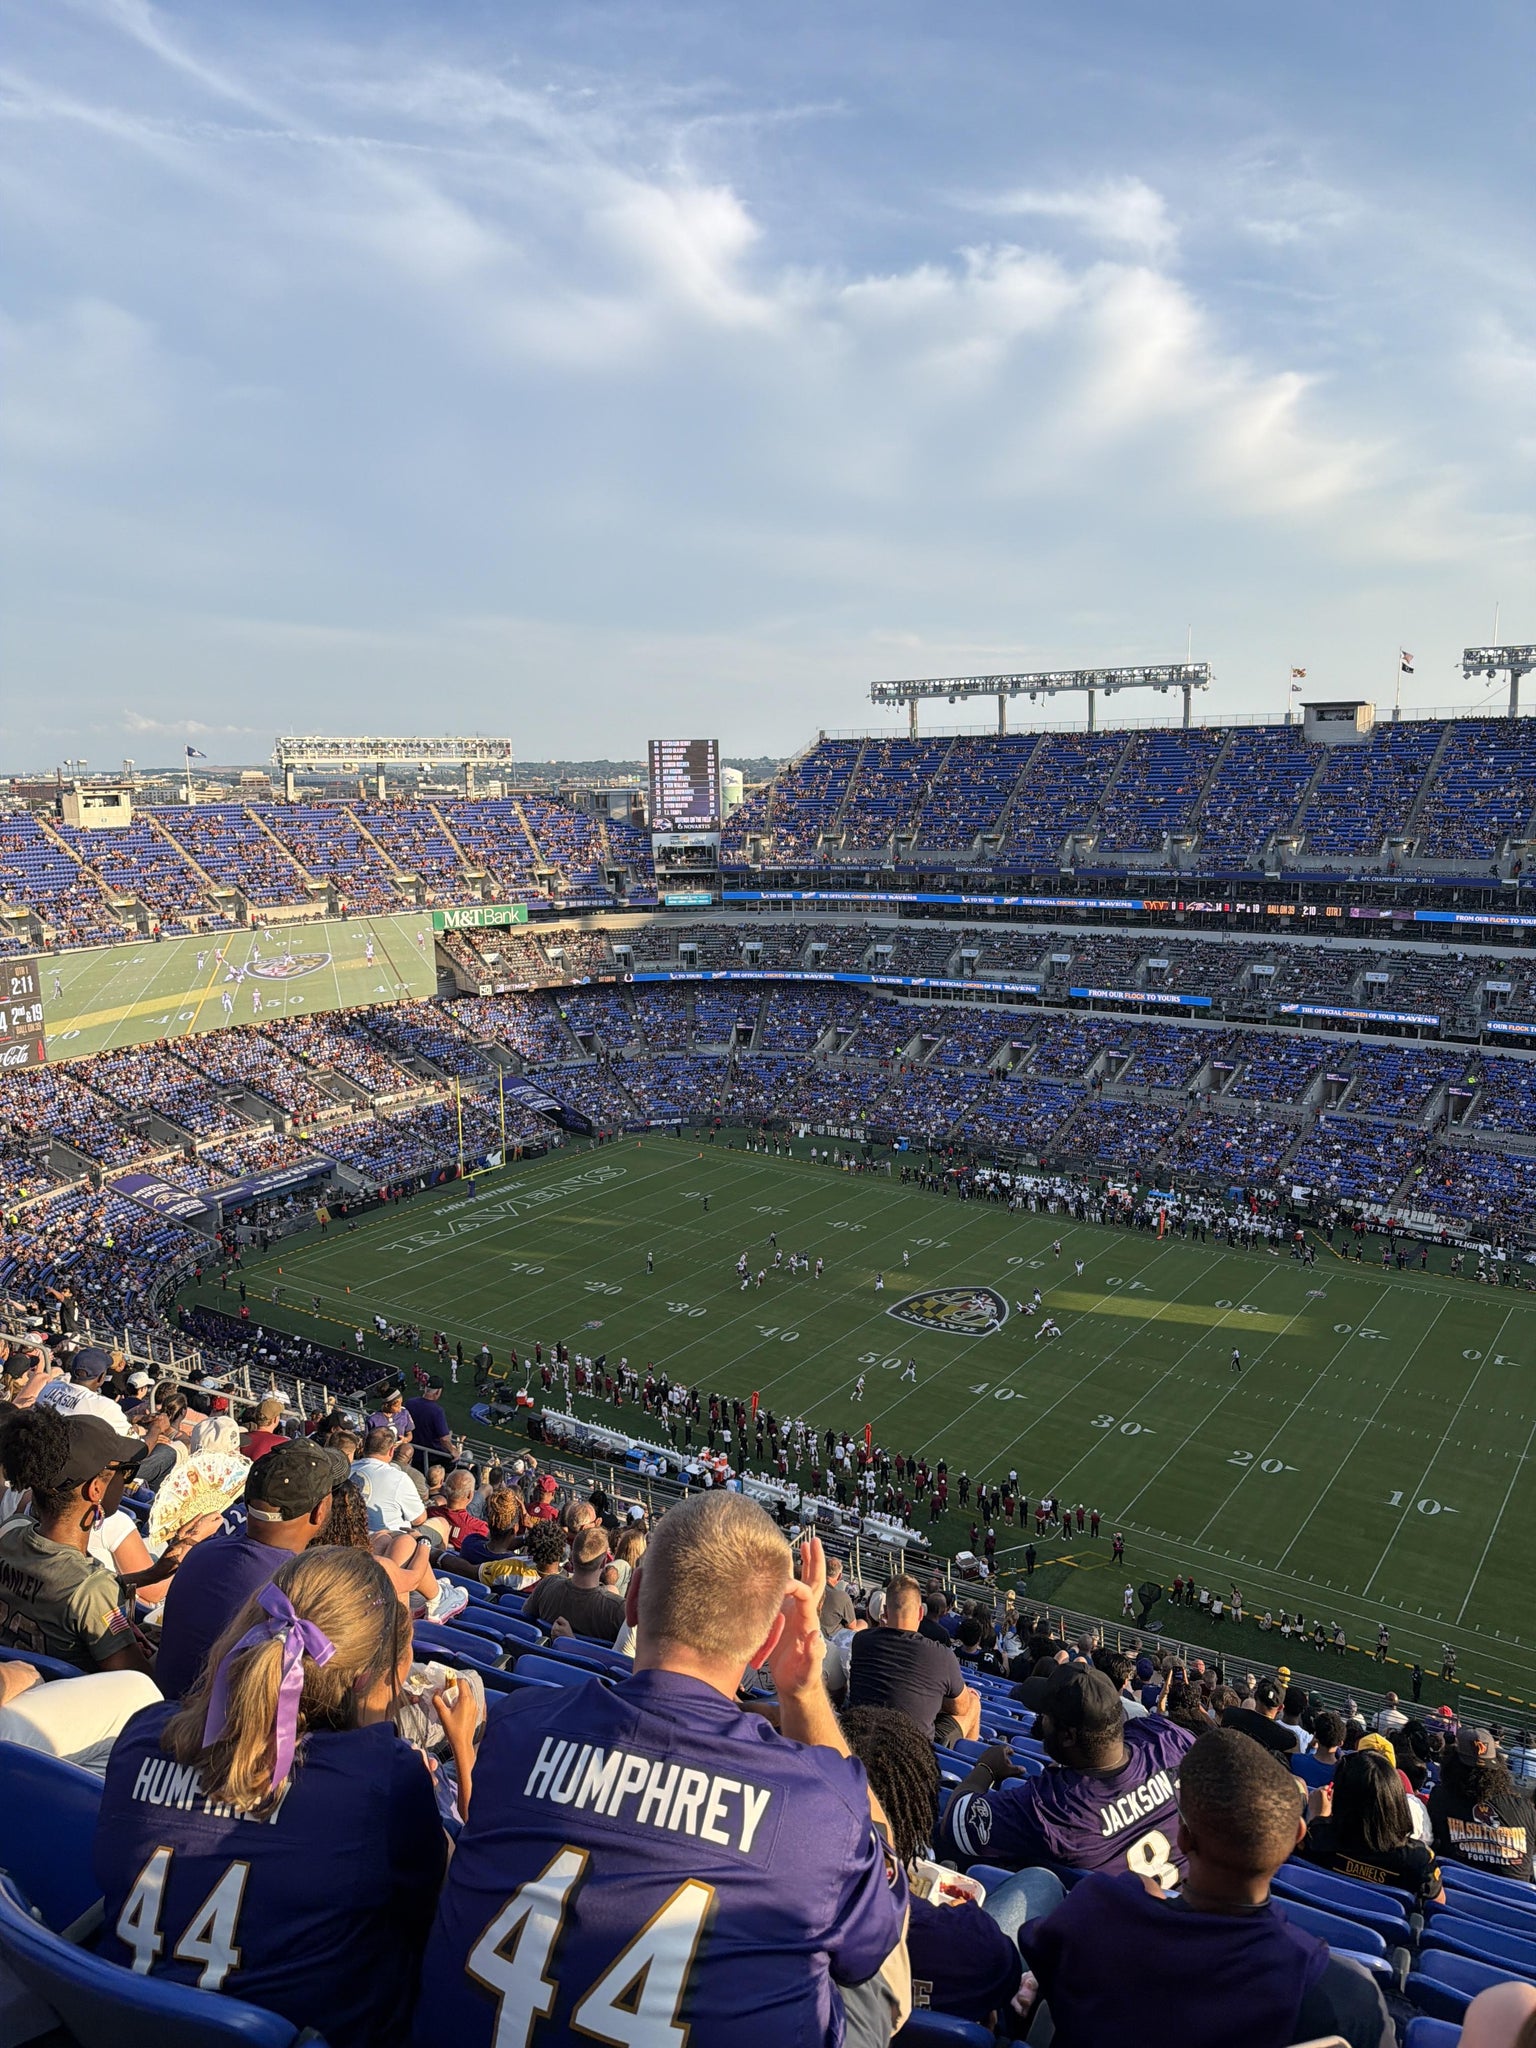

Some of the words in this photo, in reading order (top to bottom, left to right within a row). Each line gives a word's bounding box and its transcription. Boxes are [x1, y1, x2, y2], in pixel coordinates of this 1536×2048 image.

[443, 908, 483, 929] M&T
[483, 907, 520, 925] Bank
[1267, 905, 1279, 914] BALL
[1280, 905, 1287, 914] ON
[1303, 906, 1316, 915] 2:10
[1326, 907, 1338, 916] QTR
[15, 966, 25, 976] QTR
[11, 975, 33, 995] 2:11
[503, 982, 530, 991] BETMGM
[1088, 989, 1107, 997] FROM
[11, 1006, 26, 1026] 2nd
[1342, 1010, 1367, 1018] CHICKEN
[1378, 1013, 1396, 1021] YOUR
[1398, 1015, 1437, 1024] RAVENS
[16, 1024, 27, 1035] BALL
[27, 1023, 34, 1032] ON
[817, 1125, 825, 1135] OF
[826, 1126, 839, 1137] THE
[255, 1161, 327, 1185] RAVENS
[141, 1186, 173, 1200] HEALTH
[434, 1201, 465, 1216] PLAY
[468, 1181, 526, 1204] FOOTBALL
[176, 1201, 207, 1216] HEALTH
[374, 1165, 628, 1254] RAVENS
[510, 1262, 545, 1275] 10
[1006, 1256, 1046, 1270] 50
[586, 1281, 624, 1296] 20
[668, 1302, 708, 1318] 30
[1214, 1299, 1260, 1316] 30
[900, 1310, 977, 1333] RAVENS
[759, 1325, 800, 1342] 40
[1333, 1322, 1380, 1340] 20
[857, 1351, 902, 1370] 50
[1462, 1349, 1510, 1366] 10
[43, 1388, 82, 1411] JACKSON
[968, 1382, 1016, 1401] 40
[1090, 1414, 1142, 1436] 30
[1226, 1449, 1285, 1474] 20
[1383, 1490, 1442, 1515] 10
[221, 1510, 247, 1536] 22
[523, 1735, 771, 1853] HUMPHREY
[1100, 1770, 1173, 1838] JACKSON
[1447, 1816, 1528, 1854] WASHINGTON
[1459, 1841, 1519, 1859] COMMANDERS
[1467, 1852, 1511, 1866] FOOTBALL
[1345, 1859, 1387, 1884] DANIELS
[116, 1844, 250, 1991] 44
[463, 1843, 716, 2048] 44
